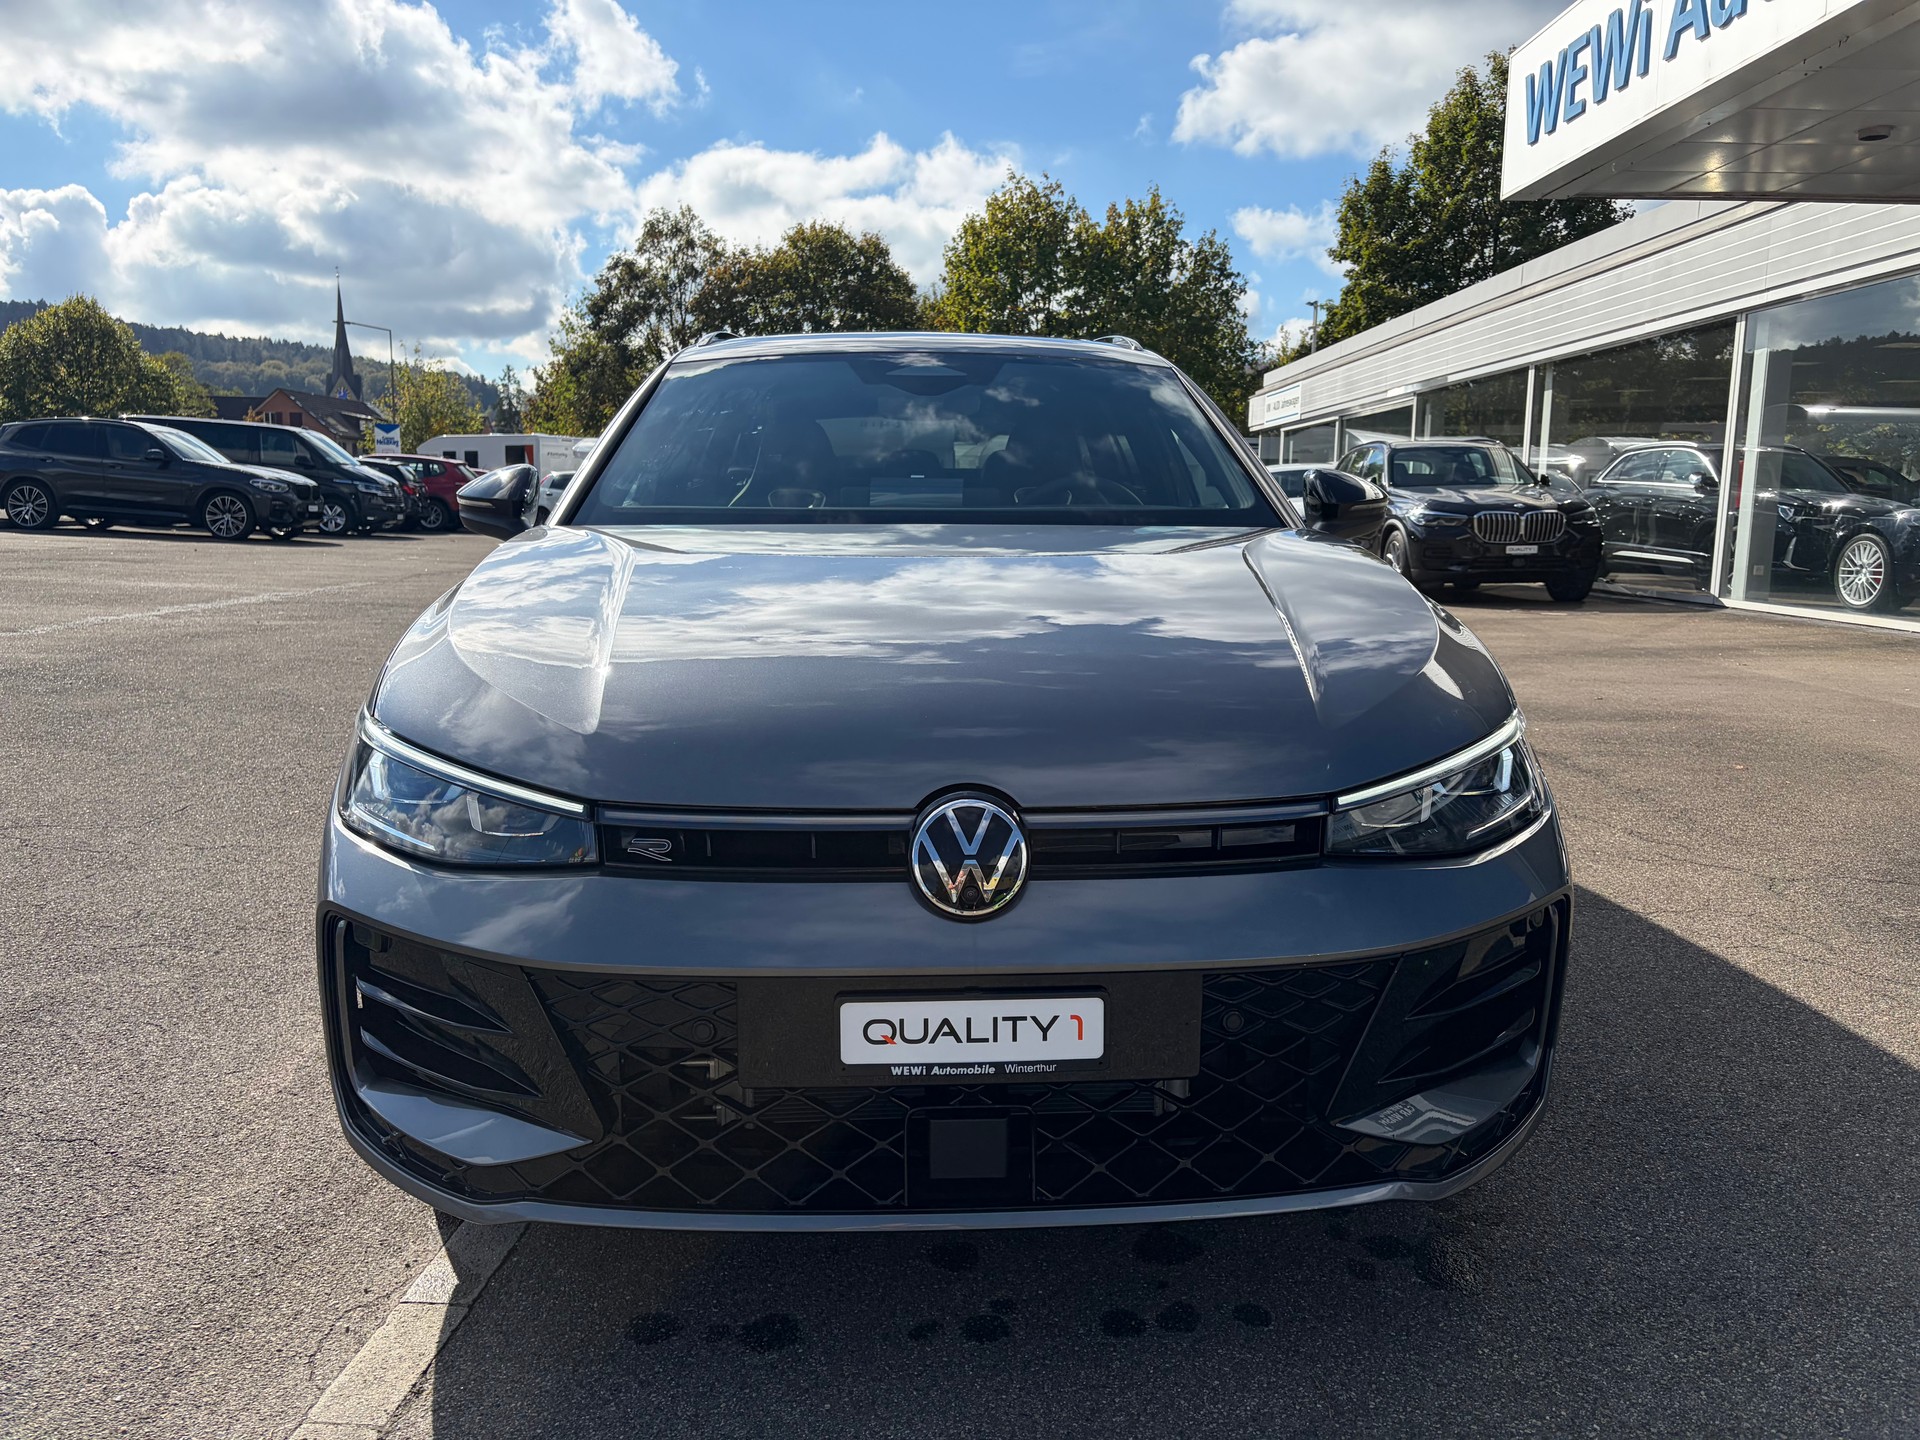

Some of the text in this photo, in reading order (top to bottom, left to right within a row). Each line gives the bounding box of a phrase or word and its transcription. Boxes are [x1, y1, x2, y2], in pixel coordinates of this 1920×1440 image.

[863, 1014, 1083, 1045] QUALITY 1
[931, 1065, 995, 1075] Automobile
[1005, 1063, 1056, 1074] Winterthur
